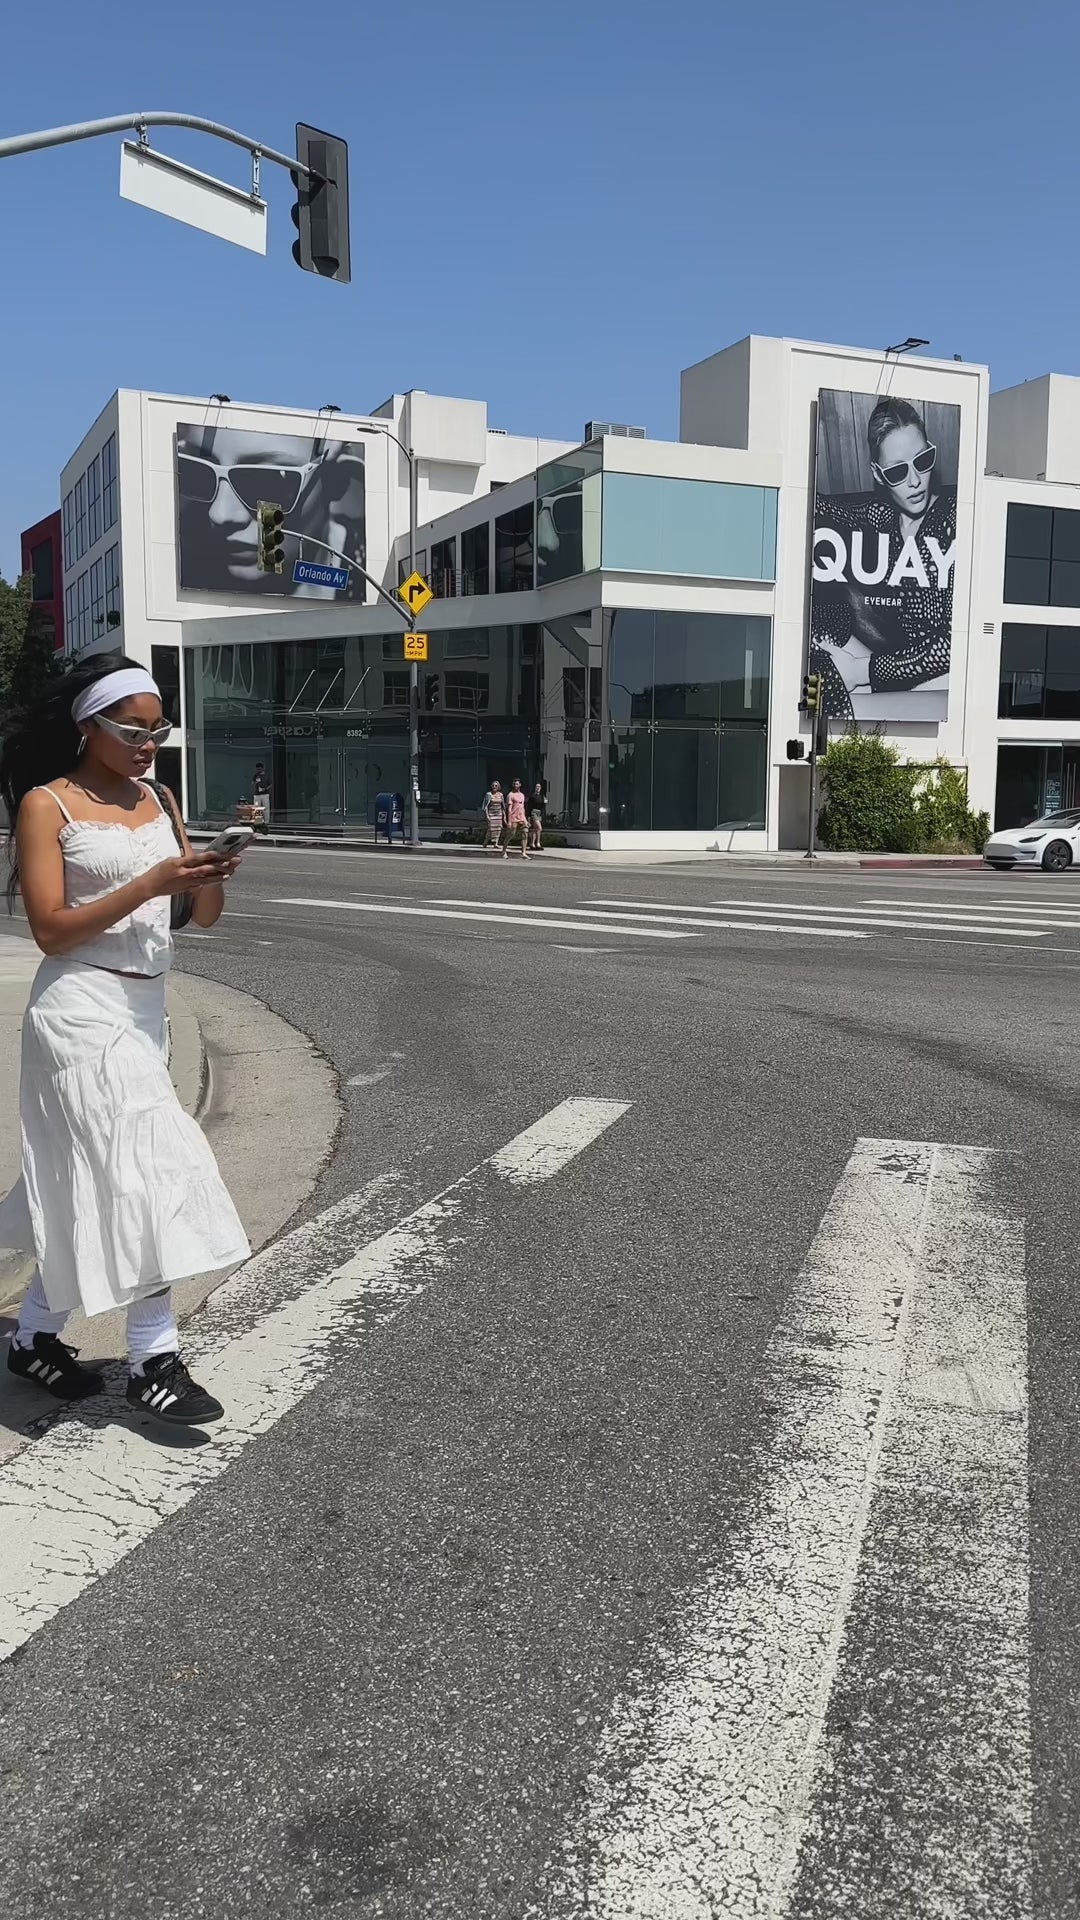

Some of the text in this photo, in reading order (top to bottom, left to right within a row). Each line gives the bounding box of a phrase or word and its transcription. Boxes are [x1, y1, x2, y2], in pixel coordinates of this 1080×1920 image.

[813, 527, 957, 589] QUAY
[299, 566, 345, 584] Orlando Av
[864, 596, 902, 607] EYEWEAR
[407, 636, 425, 649] 25
